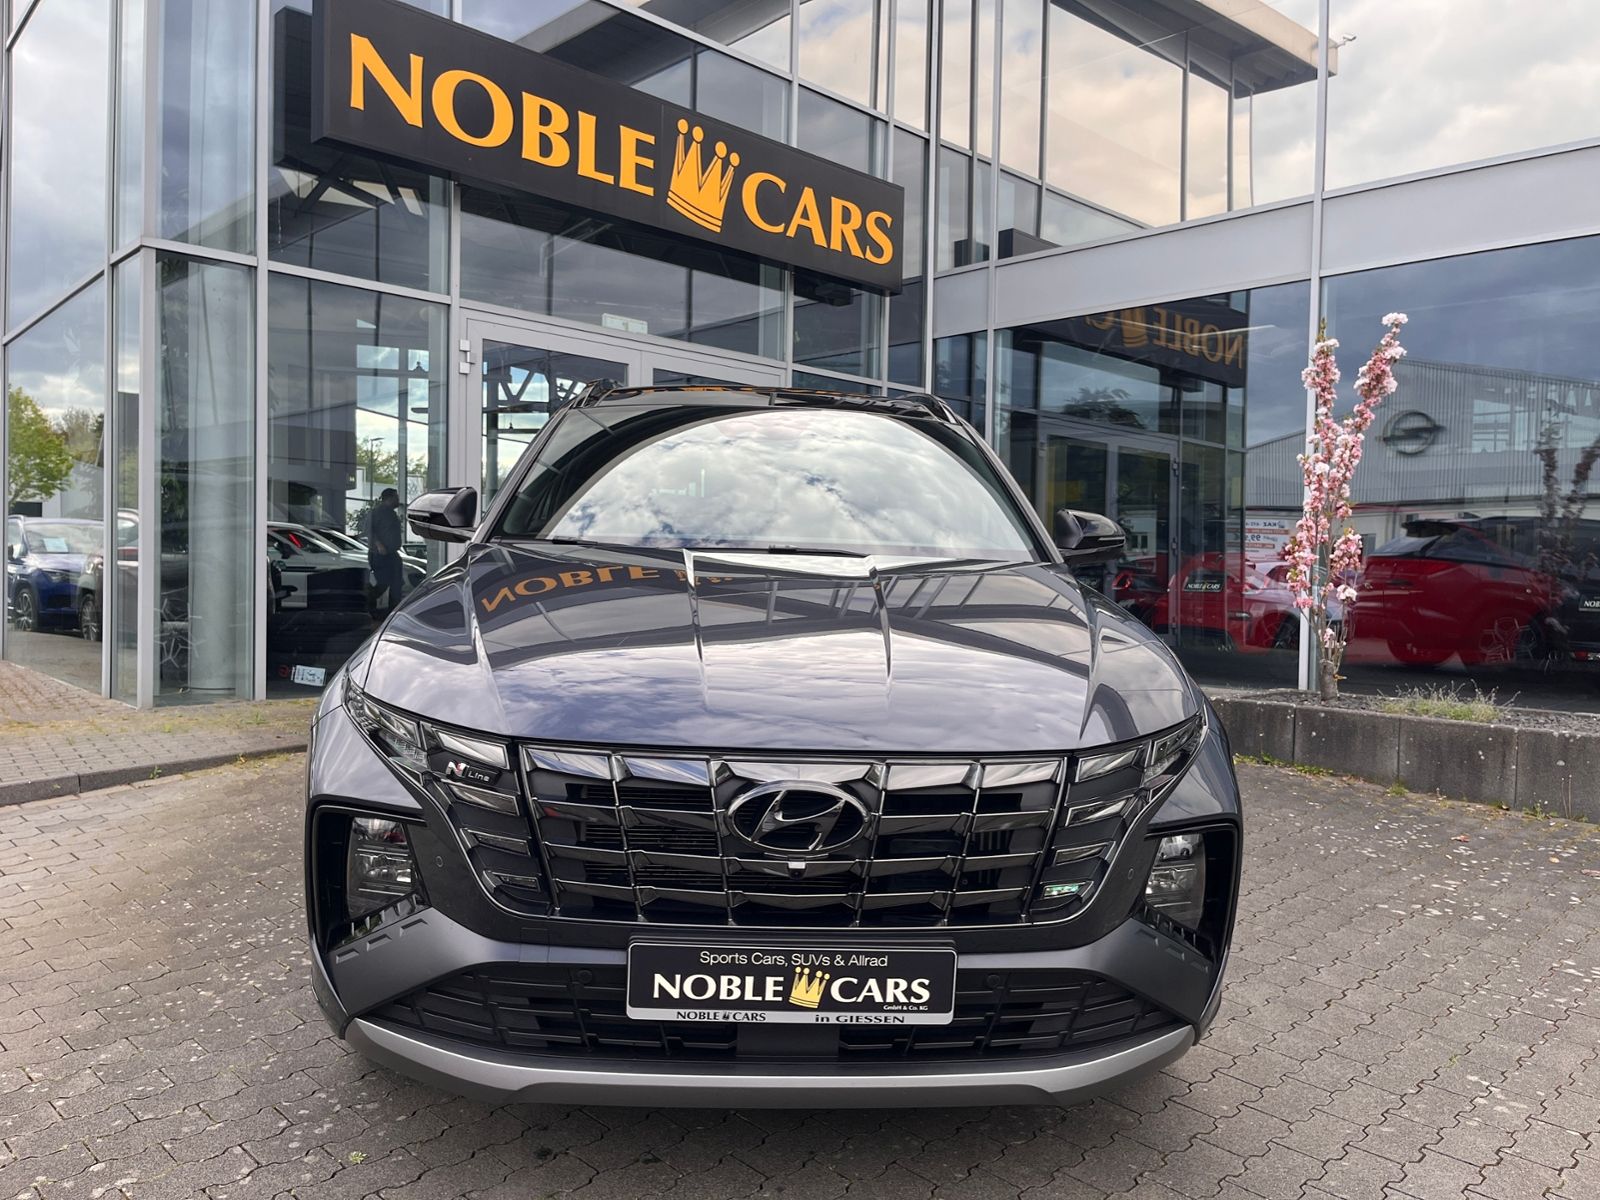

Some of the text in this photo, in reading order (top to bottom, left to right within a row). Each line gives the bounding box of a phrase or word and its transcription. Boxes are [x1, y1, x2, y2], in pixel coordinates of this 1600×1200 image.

[350, 33, 893, 265] NOBLE CARS
[446, 760, 490, 782] N Line
[700, 951, 888, 967] Sports Cars, SUVs & Allrad
[653, 973, 930, 1003] NOBLE CARS
[676, 1011, 766, 1022] NOBLE CARS
[815, 1014, 905, 1024] in GIESSEN
